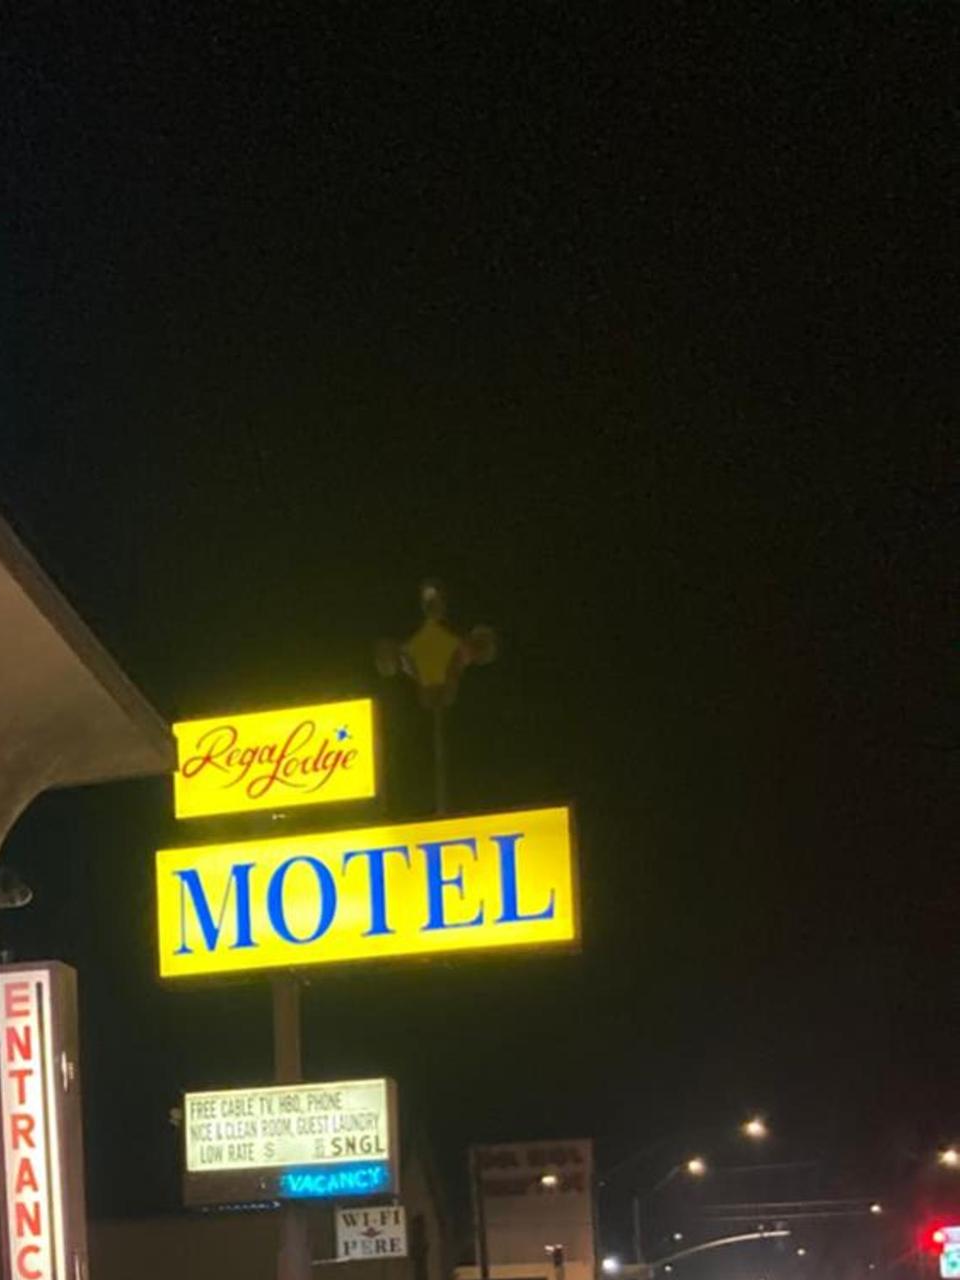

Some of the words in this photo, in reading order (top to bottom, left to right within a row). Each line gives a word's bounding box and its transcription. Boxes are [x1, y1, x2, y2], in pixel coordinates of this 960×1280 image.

[173, 833, 555, 955] MOTEL
[191, 1100, 216, 1120] FREE
[221, 1097, 254, 1118] CABLE
[307, 1091, 342, 1112] PHONE
[191, 1122, 213, 1142] NICE
[225, 1120, 257, 1140] CLEAN
[297, 1115, 328, 1135] GUEST
[333, 1111, 380, 1133] LAUNDRY
[201, 1143, 223, 1164] LOW
[228, 1141, 255, 1162] RATE
[331, 1134, 385, 1157] SNGL
[287, 1166, 381, 1193] VACANCY
[341, 1208, 401, 1228] WI-FI
